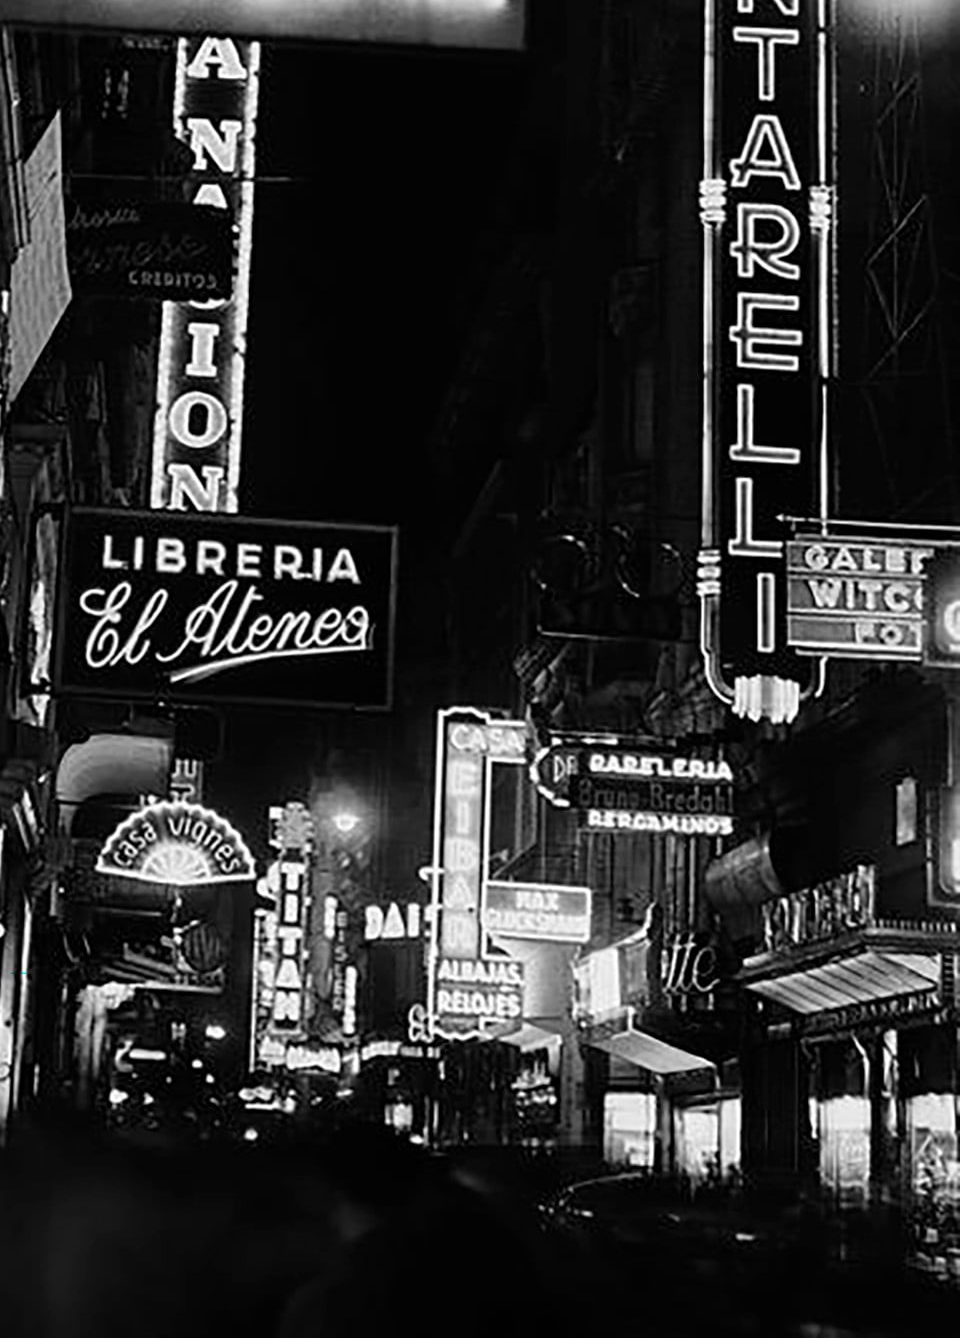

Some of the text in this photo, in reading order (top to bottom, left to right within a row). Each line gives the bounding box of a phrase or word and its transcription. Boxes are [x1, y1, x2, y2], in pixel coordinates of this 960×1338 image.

[128, 270, 217, 290] CREDITOS
[102, 535, 362, 584] LIBRERIA
[80, 579, 371, 670] El Ateneo
[450, 722, 526, 754] CASA
[437, 989, 522, 1016] RELOJES
